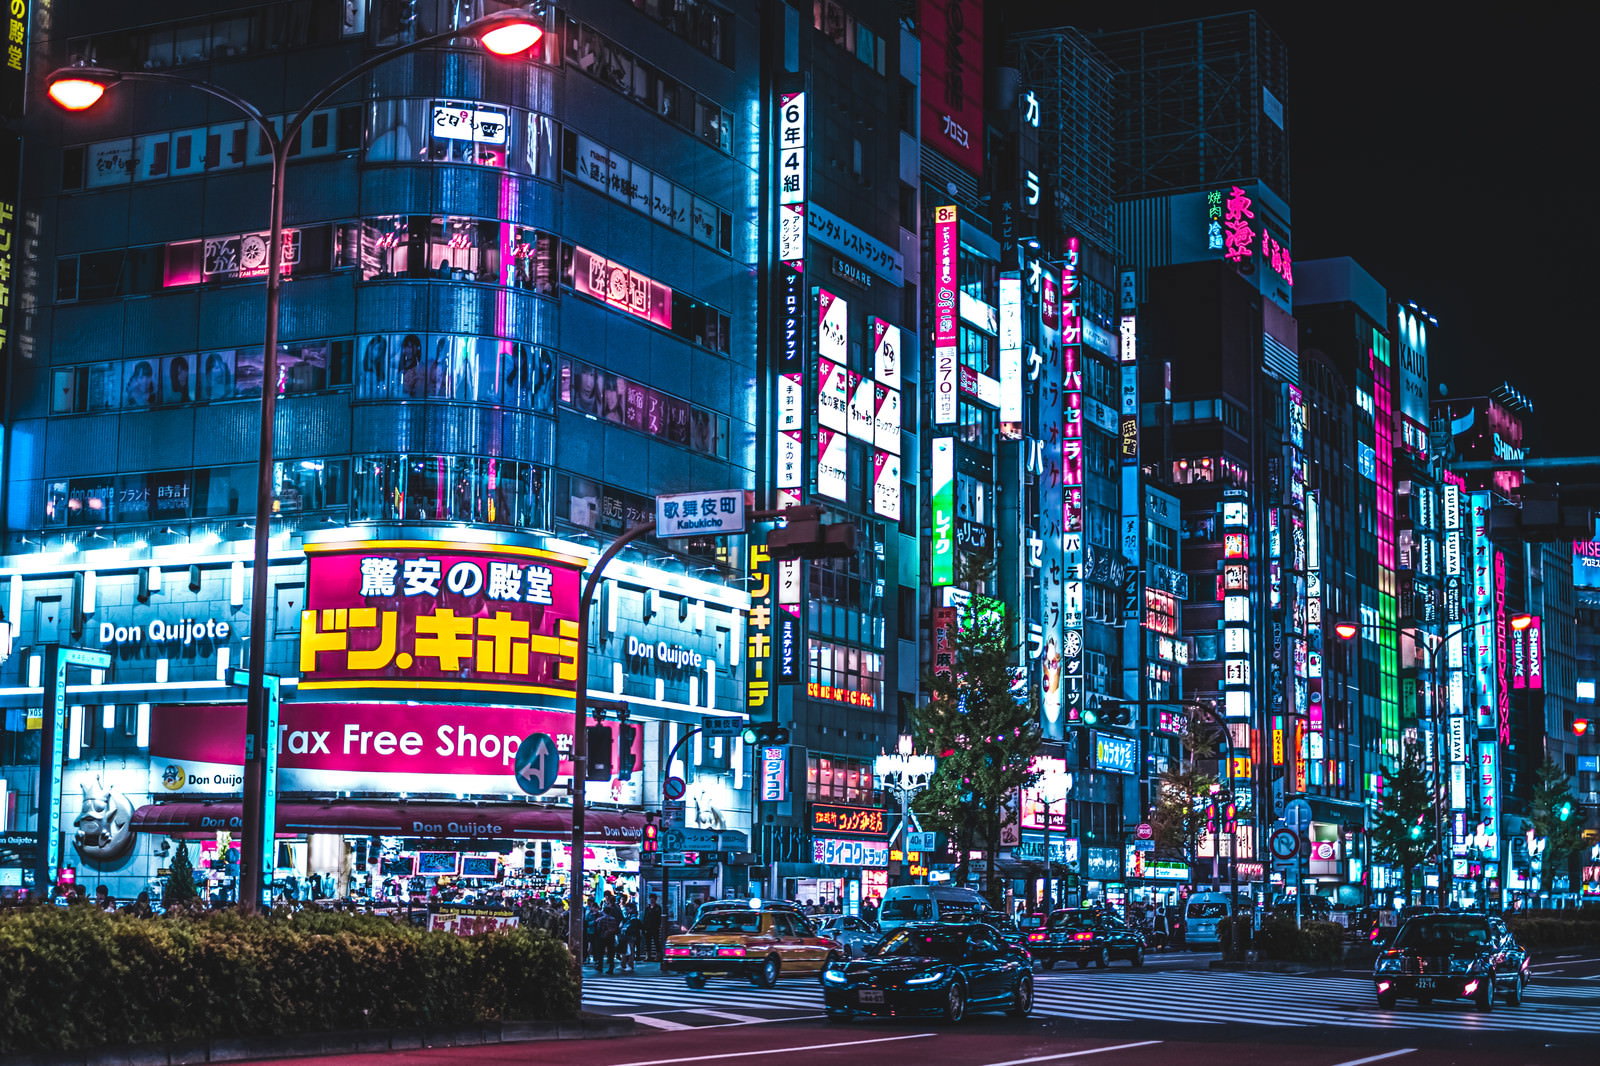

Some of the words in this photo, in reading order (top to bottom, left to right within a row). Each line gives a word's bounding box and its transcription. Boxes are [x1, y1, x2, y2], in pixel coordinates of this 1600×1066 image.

[784, 104, 801, 193] 6年4組
[943, 115, 969, 149] プロミス
[809, 210, 841, 241] エンタメ
[843, 230, 902, 272] レストランタワー
[838, 261, 871, 287] SQUARE
[786, 275, 797, 361] ザ・ロックアップ
[158, 484, 191, 499] 時計
[603, 496, 623, 519] 販売
[664, 496, 737, 519] 歌舞伎町
[1447, 488, 1456, 526] TSUTAYA
[677, 518, 723, 531] Kabukicho
[936, 510, 950, 555] レイク
[1449, 533, 1458, 574] TSUTAYA
[361, 558, 553, 605] 驚安の殿堂
[1125, 571, 1136, 609] 747
[100, 622, 141, 643] Don
[149, 618, 230, 644] Quijote
[783, 621, 793, 675] ミステリアス
[629, 636, 654, 659] Don
[658, 642, 702, 669] Quijote
[1530, 628, 1539, 677] SHIDAX
[278, 725, 331, 756] Tax
[344, 724, 422, 756] Free
[436, 724, 522, 766] Shop
[1452, 719, 1461, 760] TSUTAYA
[188, 774, 210, 785] Don
[767, 761, 781, 800] ダイコク
[201, 816, 225, 828] Don
[412, 821, 443, 835] Don
[447, 821, 502, 837] Quijote
[604, 825, 621, 837] Don
